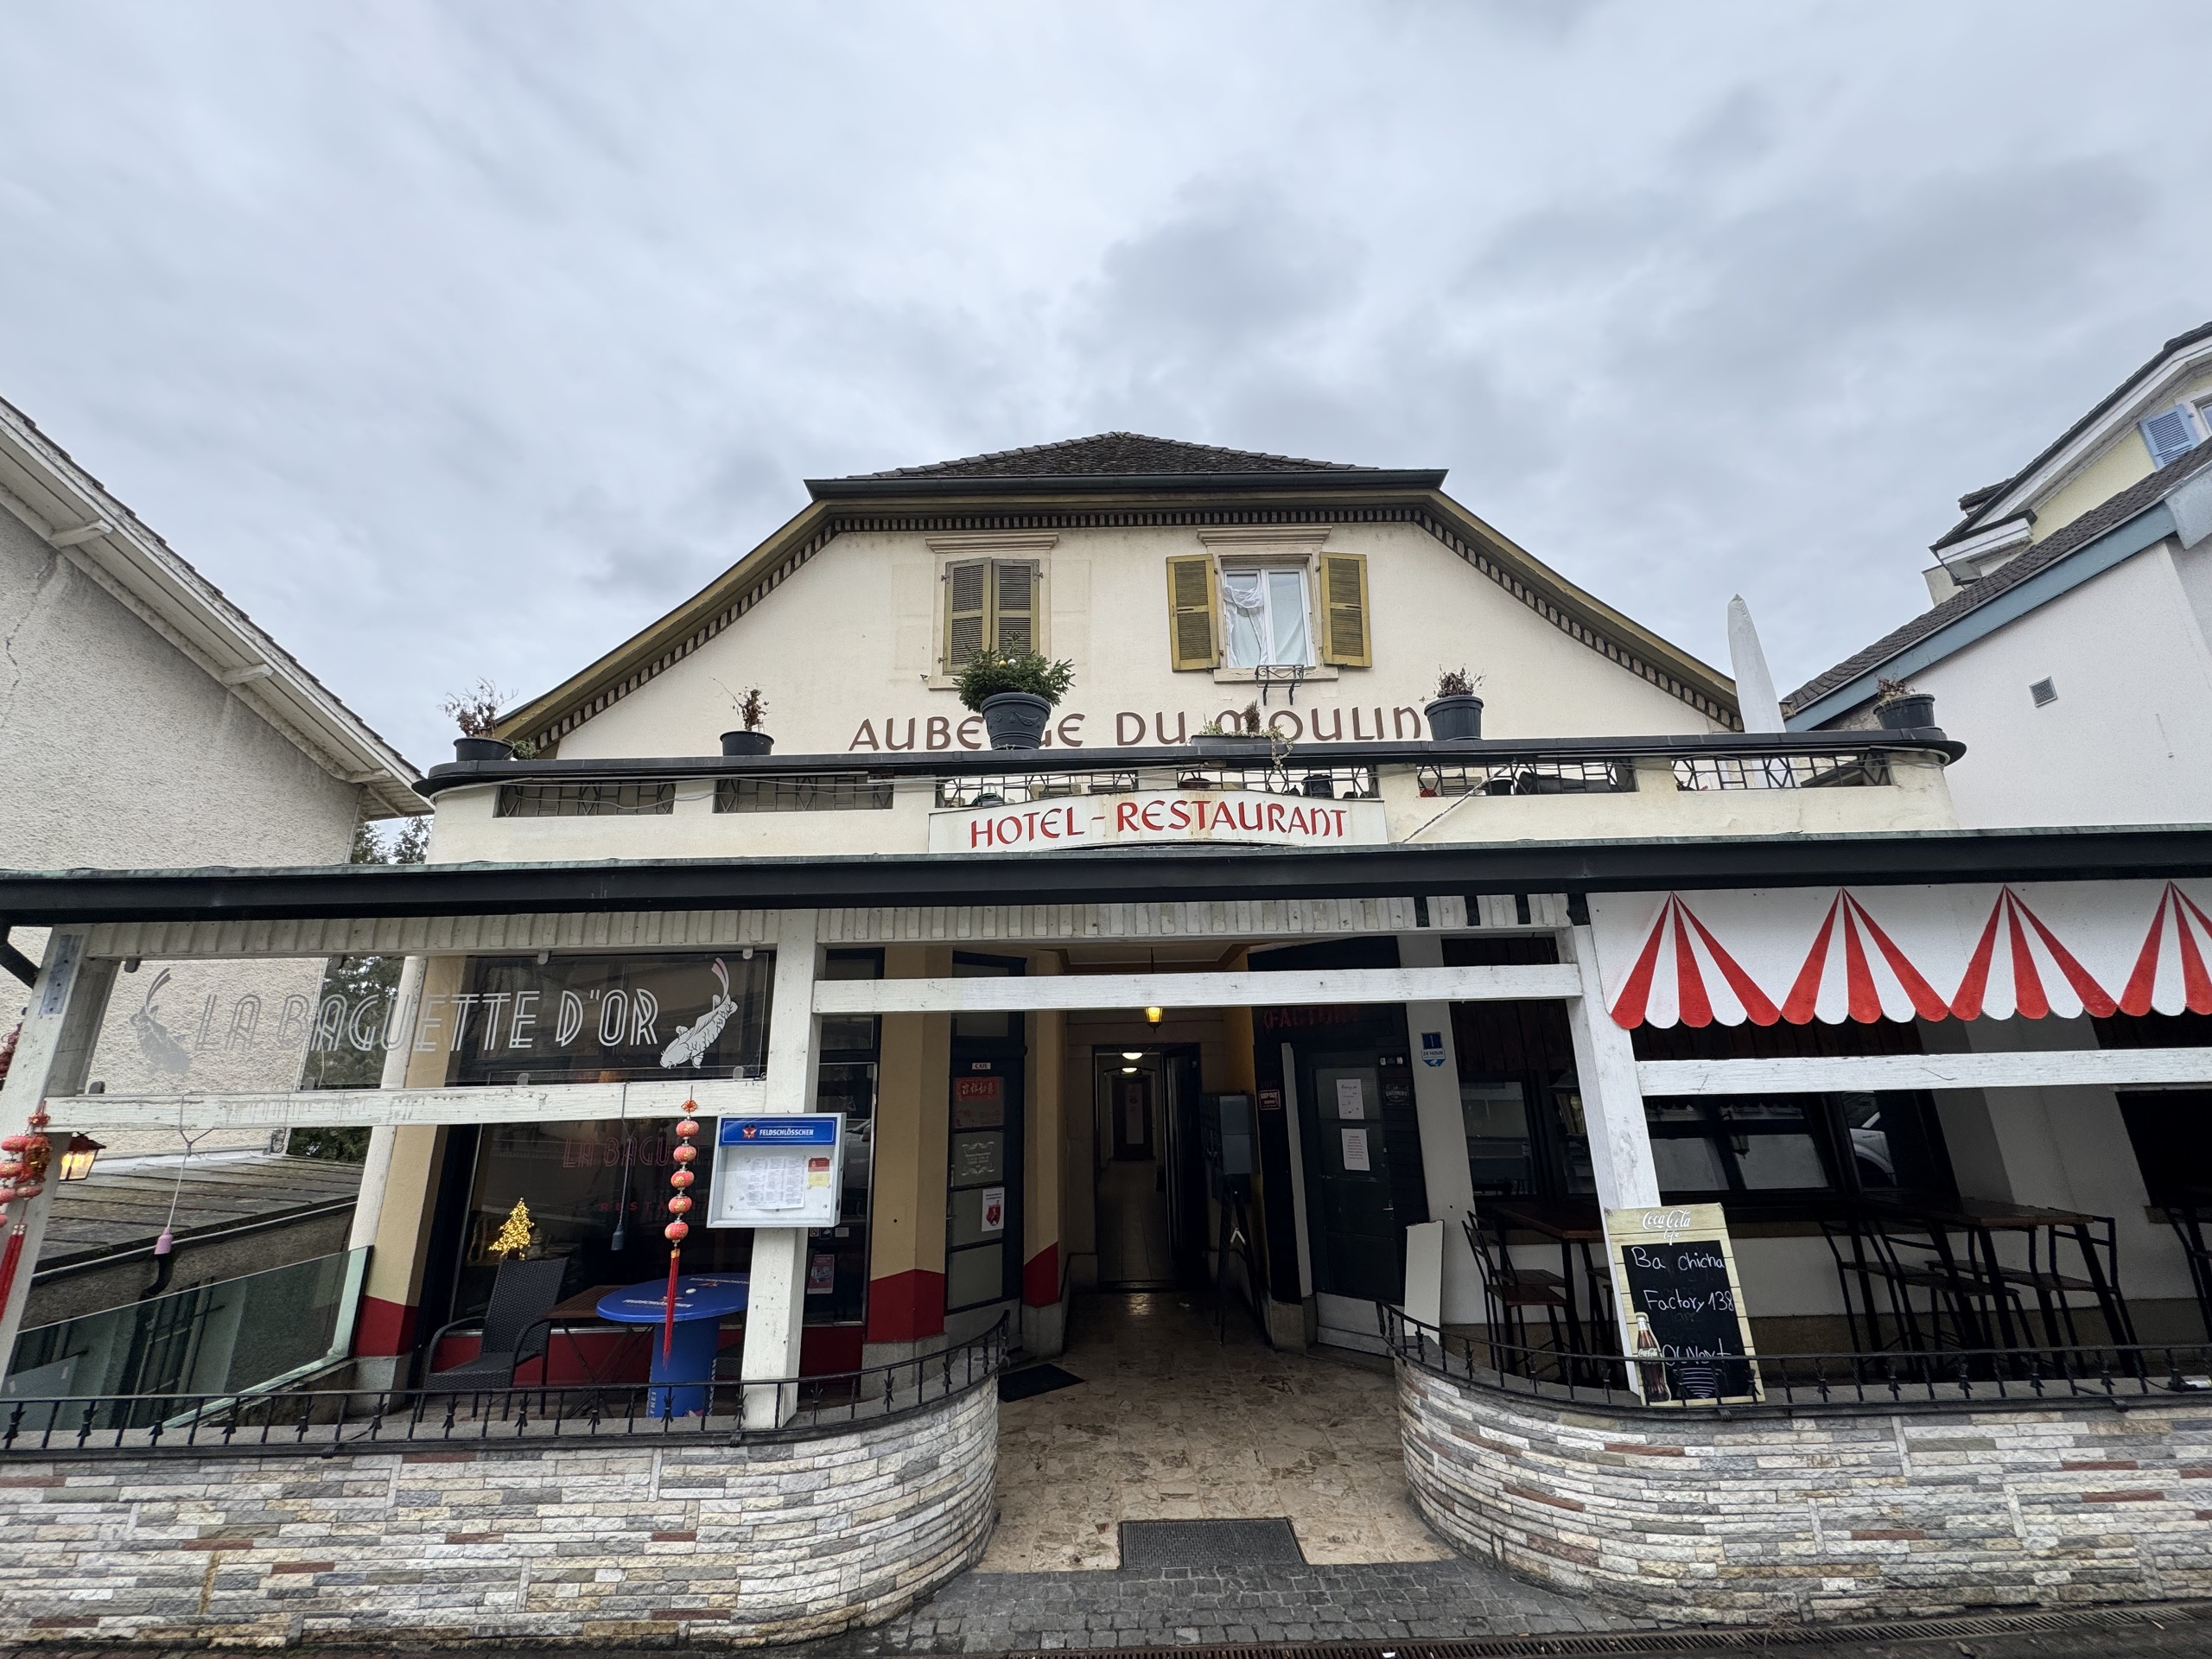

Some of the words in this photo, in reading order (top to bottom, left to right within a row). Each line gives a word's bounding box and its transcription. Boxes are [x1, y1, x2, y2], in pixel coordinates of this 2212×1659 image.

[849, 713, 1085, 752] AUBEE
[1116, 710, 1186, 746] DU
[970, 805, 1085, 849] HOTEL
[1116, 799, 1348, 838] RESTAURANT
[194, 994, 262, 1052] LA
[276, 990, 540, 1052] BAGUETTE
[563, 1138, 594, 1168] LA
[1642, 1209, 1691, 1230] Coca-Cola
[1630, 1246, 1667, 1269] Ba
[1643, 1288, 1705, 1313] Factory
[1707, 1290, 1734, 1312] 138
